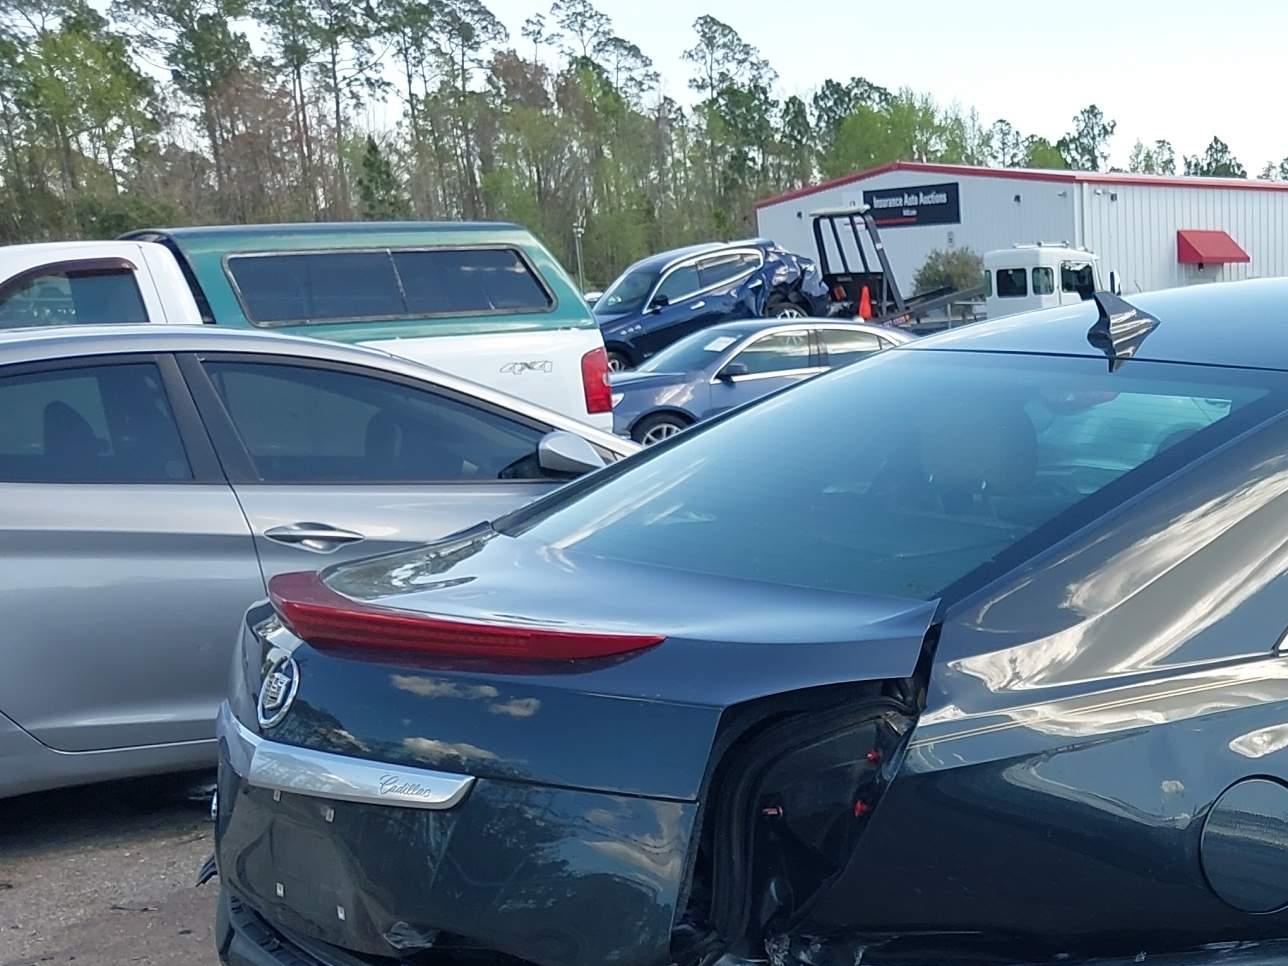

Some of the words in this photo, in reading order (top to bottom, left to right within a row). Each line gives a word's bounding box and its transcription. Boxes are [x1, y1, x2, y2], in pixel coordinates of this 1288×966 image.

[904, 192, 918, 206] Auto
[919, 191, 947, 205] Auctions
[379, 774, 432, 798] Cadillac
